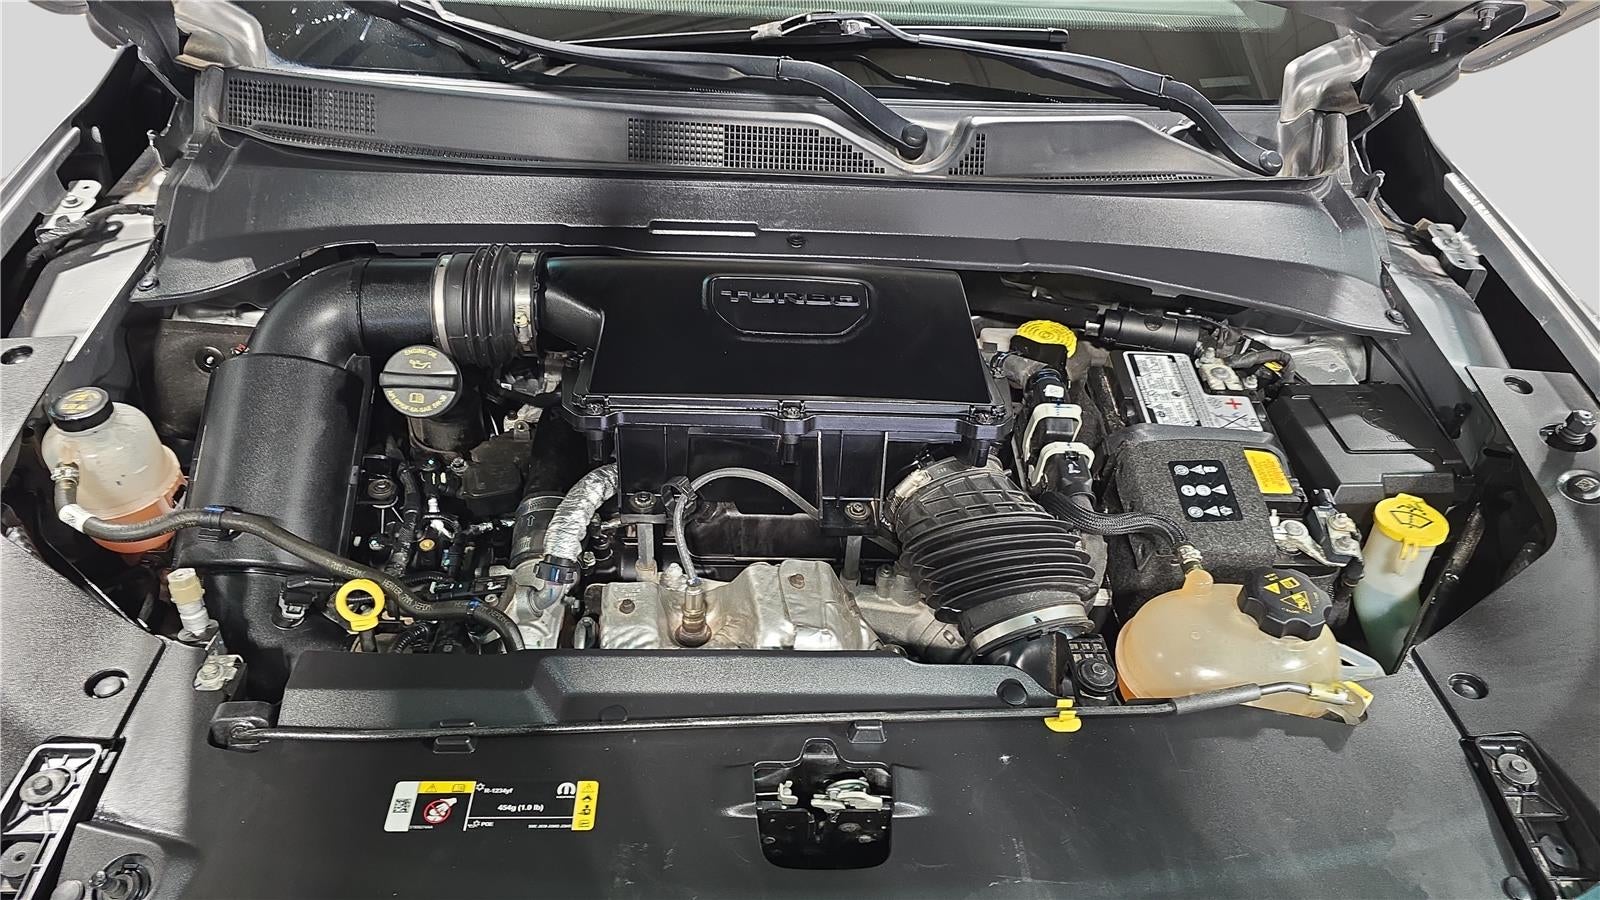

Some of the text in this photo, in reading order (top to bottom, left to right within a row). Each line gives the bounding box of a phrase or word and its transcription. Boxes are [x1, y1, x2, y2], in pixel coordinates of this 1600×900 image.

[720, 290, 861, 307] TURBO
[404, 348, 437, 359] ENGINE OIL
[484, 787, 514, 795] R-1234yf
[497, 804, 544, 812] 454g (1.0 lb)
